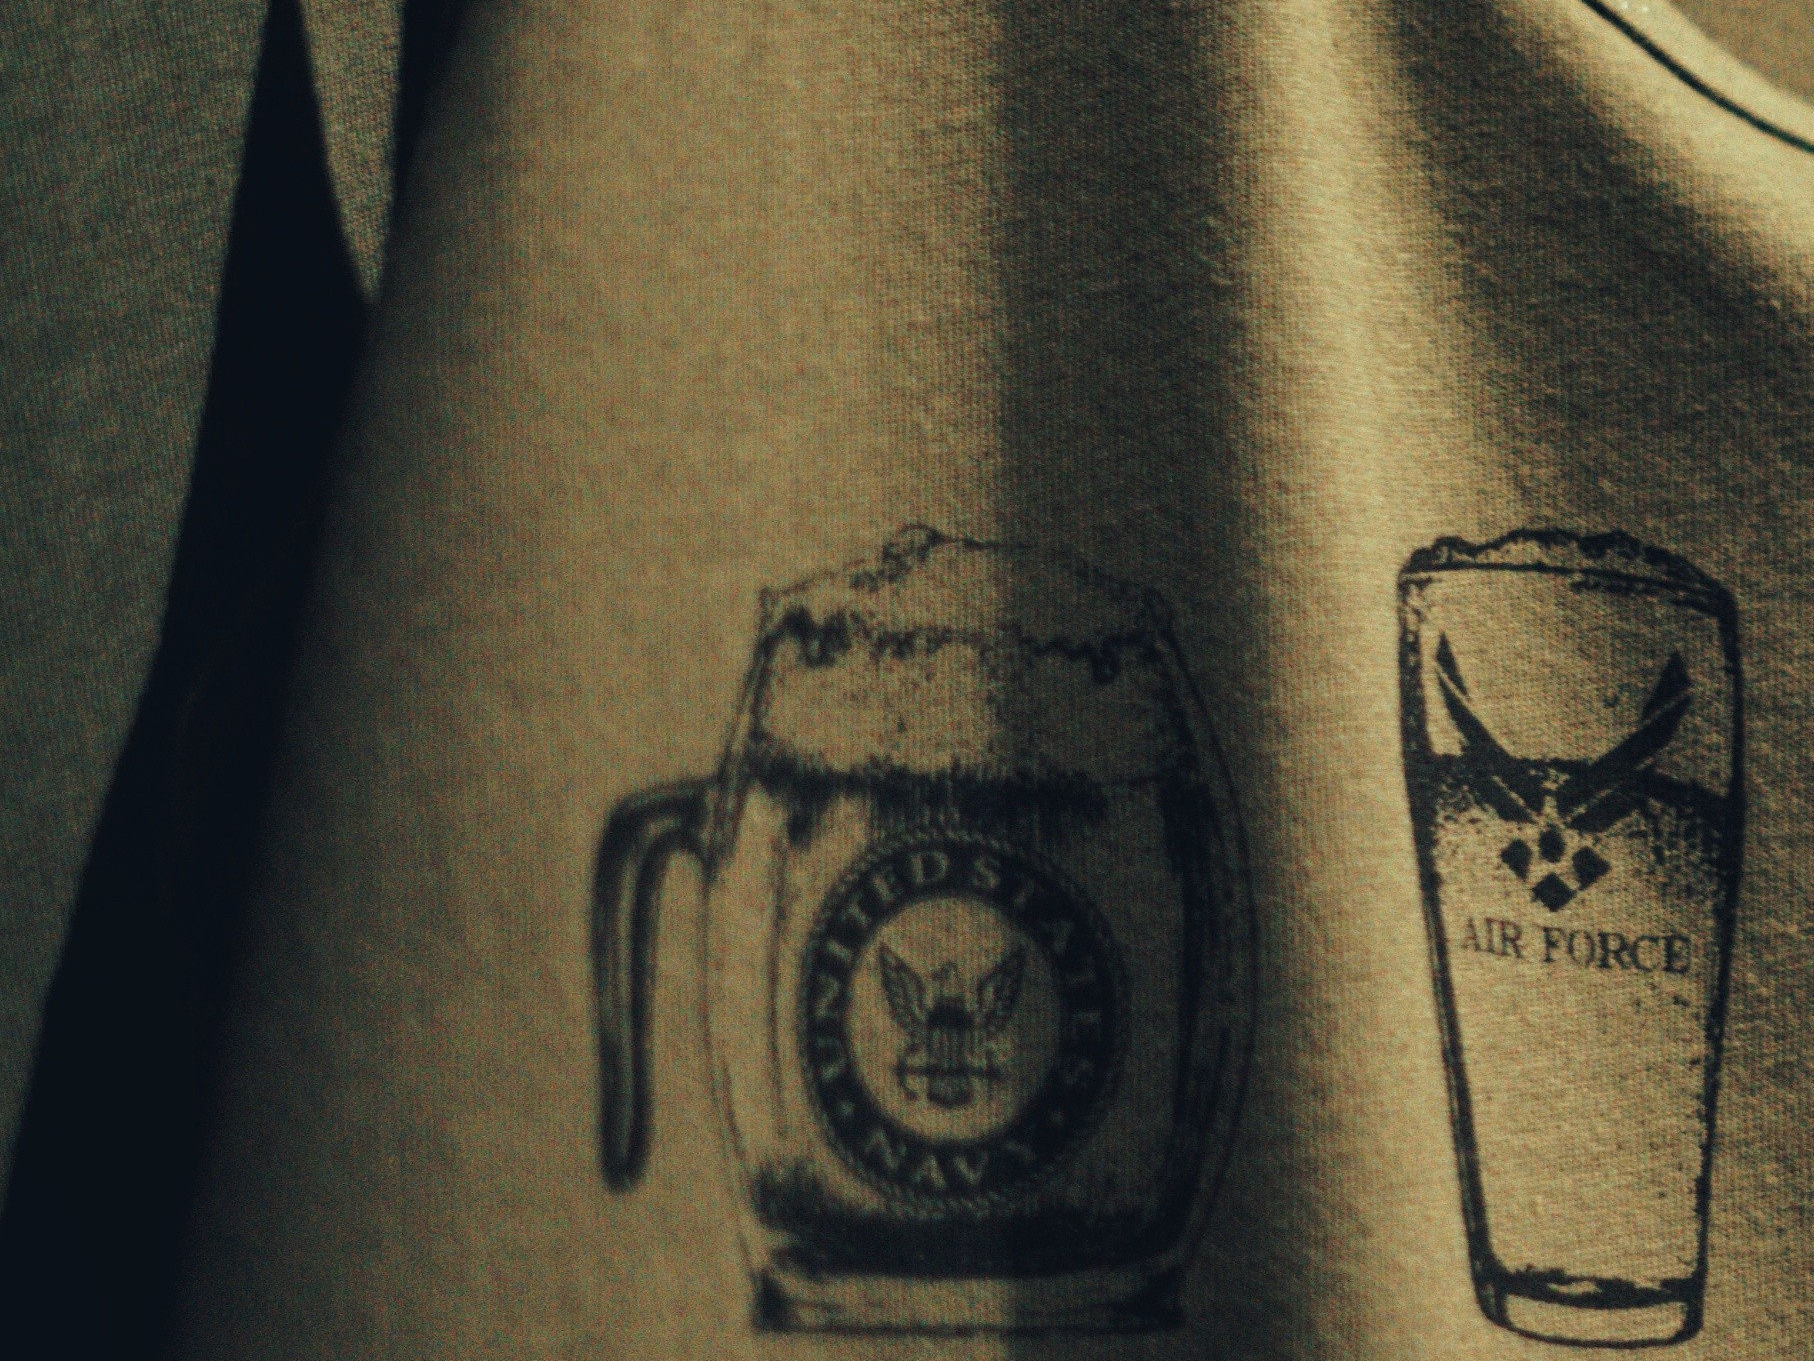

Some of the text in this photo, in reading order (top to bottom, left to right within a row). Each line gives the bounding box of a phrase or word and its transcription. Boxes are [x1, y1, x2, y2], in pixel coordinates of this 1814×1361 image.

[813, 849, 1103, 1085] UNITED STATES
[1461, 916, 1692, 975] AIR FORCE
[860, 1124, 1036, 1190] NAVY
